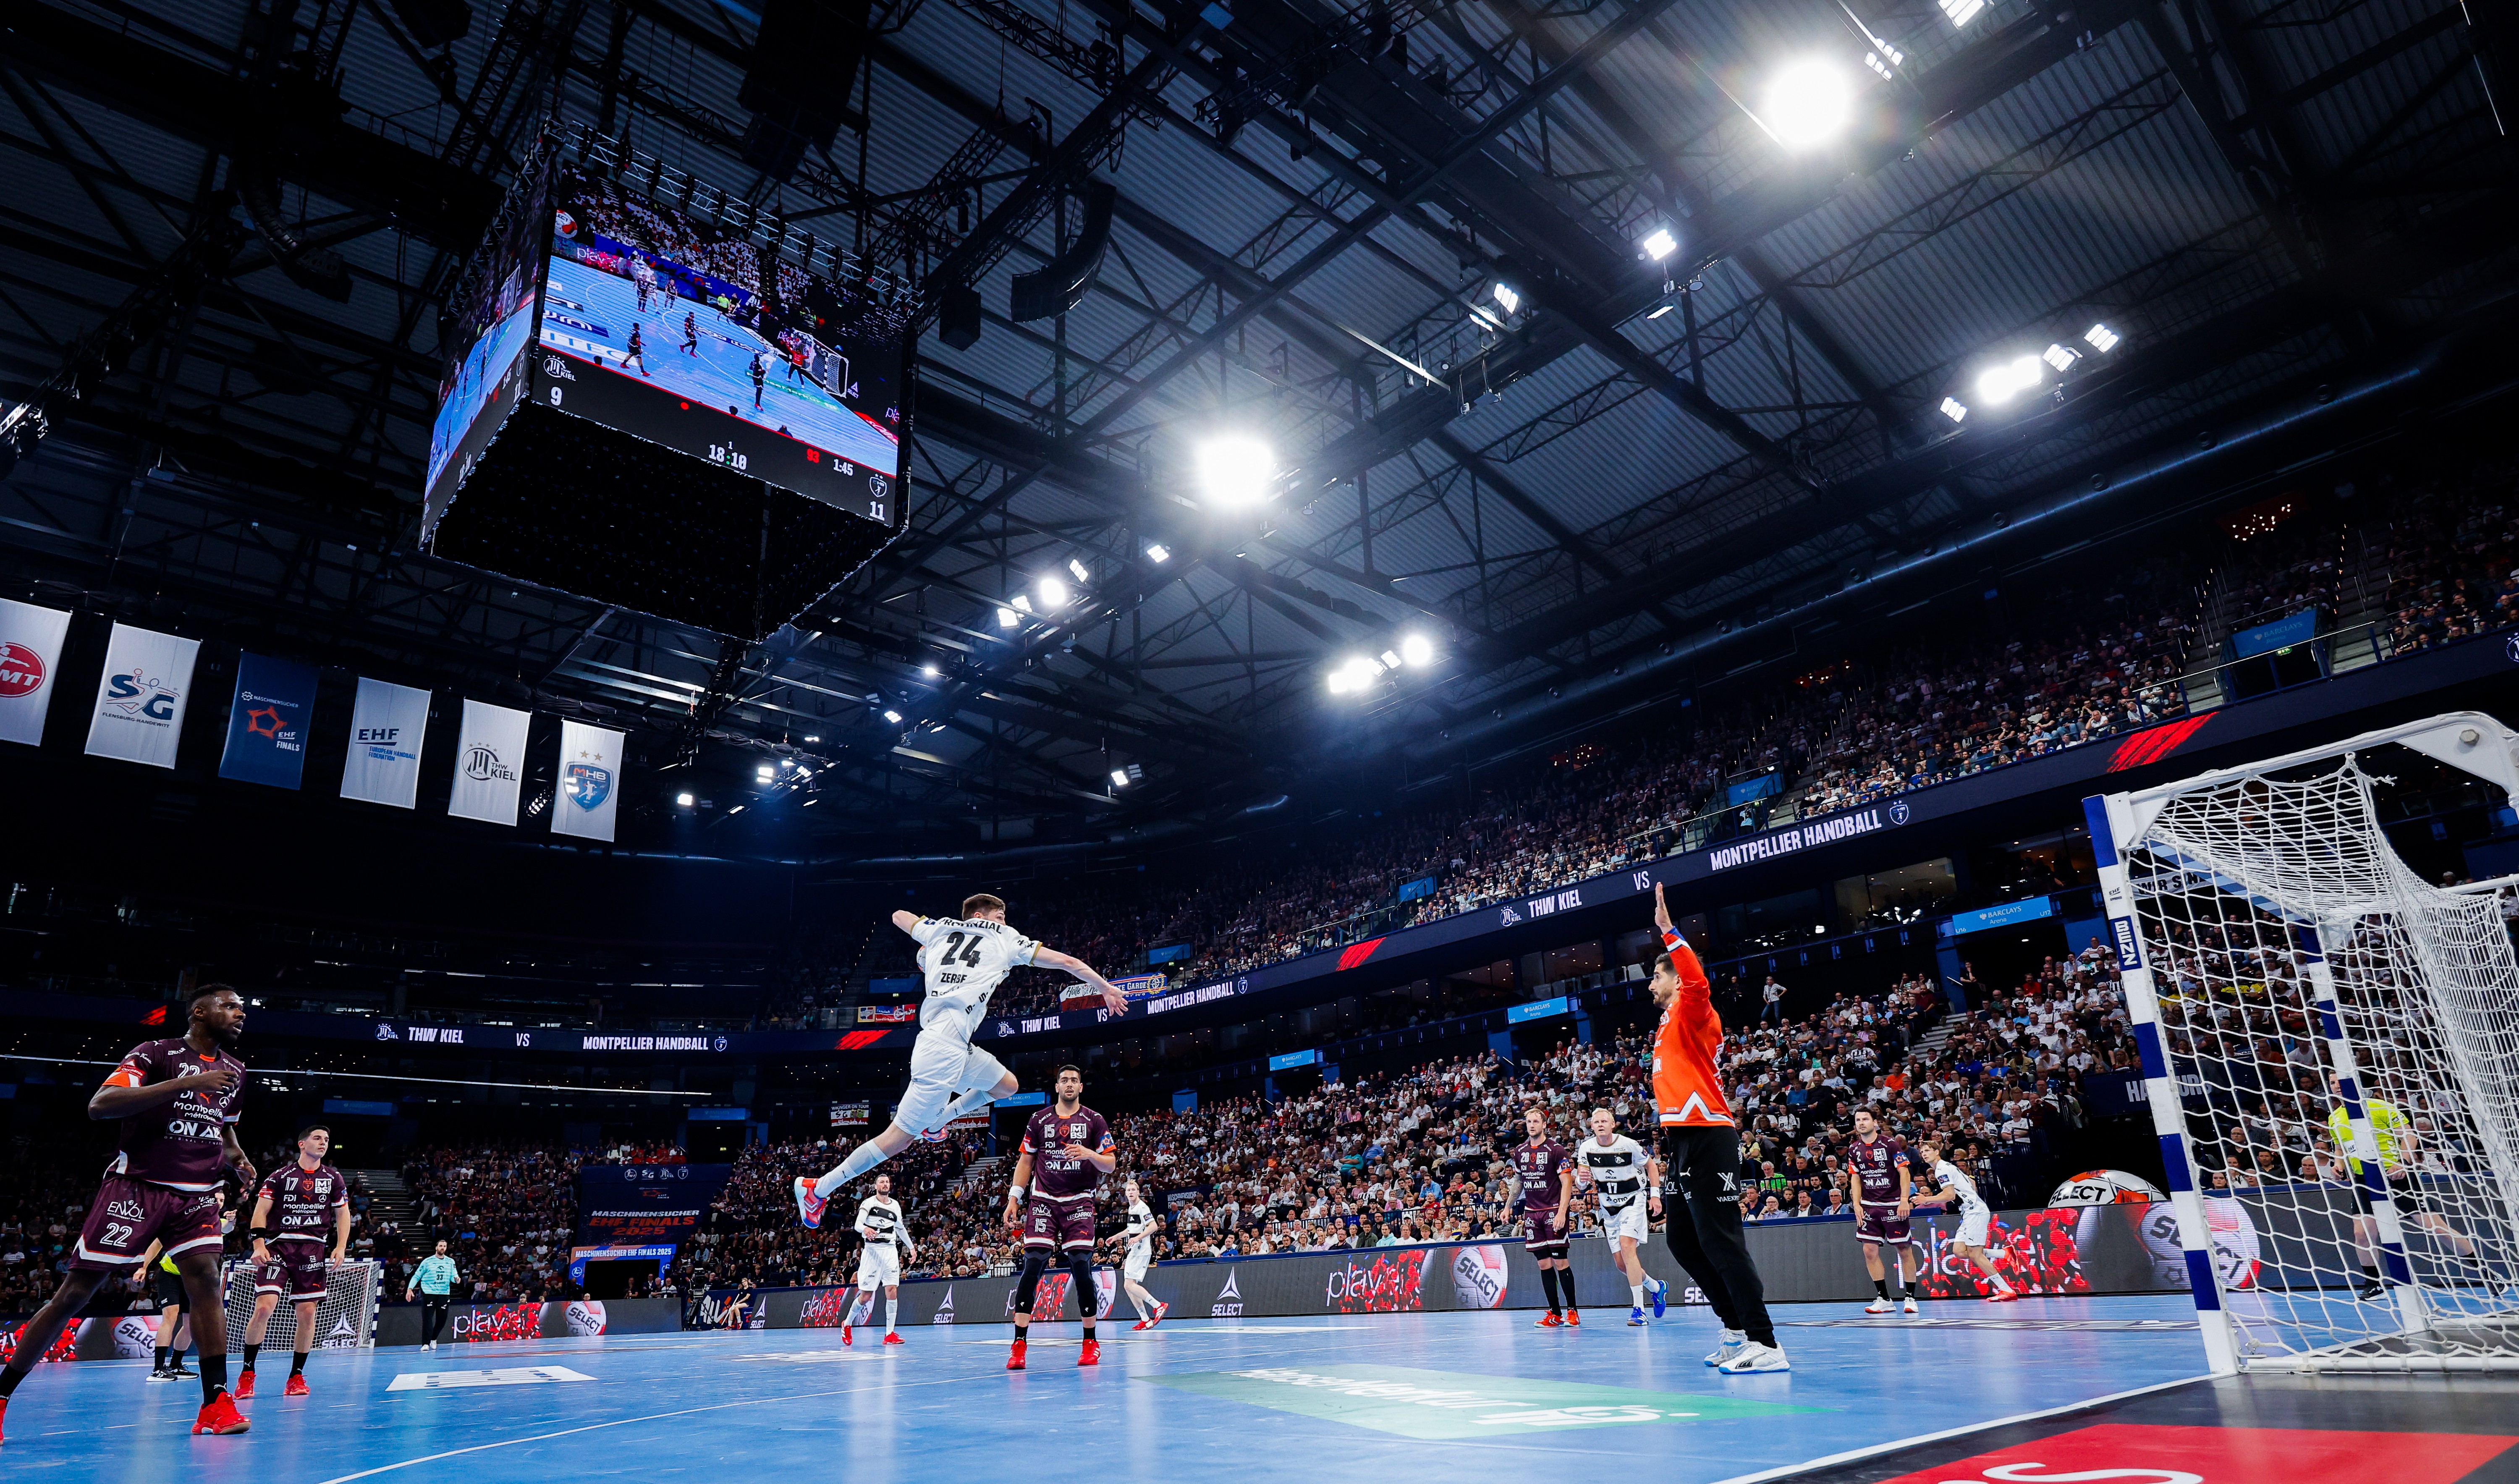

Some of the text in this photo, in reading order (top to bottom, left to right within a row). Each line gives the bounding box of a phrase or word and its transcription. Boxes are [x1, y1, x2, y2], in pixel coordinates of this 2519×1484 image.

[560, 371, 576, 382] KIEL
[550, 387, 563, 406] 9
[728, 441, 732, 450] 1
[709, 444, 747, 470] 18:10
[806, 448, 820, 463] 93
[833, 458, 854, 476] 1:45
[869, 501, 885, 521] 11
[108, 674, 175, 720] SG
[254, 695, 299, 708] MASCHINENSUCHER
[102, 712, 170, 728] FLENSBURG-HANDEWITT
[358, 728, 399, 741] EHF
[276, 741, 300, 751] FINALS
[369, 746, 416, 760] EUROPEAN HANDBALL
[369, 752, 395, 762] FEDERATION
[490, 768, 516, 781] KIEL
[573, 767, 606, 780] MHB
[1710, 809, 1883, 872] MONTPELLIER HANDBALL
[1632, 870, 1650, 890] VS
[1527, 888, 1582, 918] THW KIEL
[1988, 906, 2021, 919] BARCLAYS
[940, 931, 984, 968] 24
[2114, 920, 2138, 966] BENZ
[1147, 981, 1234, 1014] MONTPELLIER HANDBALL
[1529, 1003, 1550, 1011] BARCLAYS
[1097, 1009, 1108, 1022] VS
[1021, 1016, 1060, 1033] THW KIEL
[408, 1027, 463, 1043] THW KIEL
[516, 1033, 530, 1047] VS
[583, 1036, 708, 1050] MONTPELLIER HANDBALL
[178, 1063, 200, 1078] 22
[169, 1120, 198, 1136] ON
[1044, 1124, 1055, 1138] 15
[1521, 1152, 1529, 1162] 28
[1856, 1152, 1861, 1162] 2
[1045, 1161, 1081, 1170] ON AIR
[285, 1177, 299, 1191] 17
[1607, 1182, 1617, 1193] 17
[2050, 1186, 2106, 1206] SELECT
[282, 1216, 301, 1225] ON
[589, 1217, 695, 1226] EHF FINALS
[1034, 1218, 1047, 1233] 15
[100, 1222, 133, 1248] 22
[575, 1249, 626, 1258] MASCHINENSUCHER
[266, 1266, 280, 1280] 17
[1457, 1256, 1498, 1302] SELECT
[1211, 1303, 1243, 1316] SELECT
[568, 1307, 600, 1333] SELECT
[750, 1319, 765, 1329] SELECT
[933, 1313, 954, 1323] SELECT
[118, 1323, 155, 1351] SELEC
